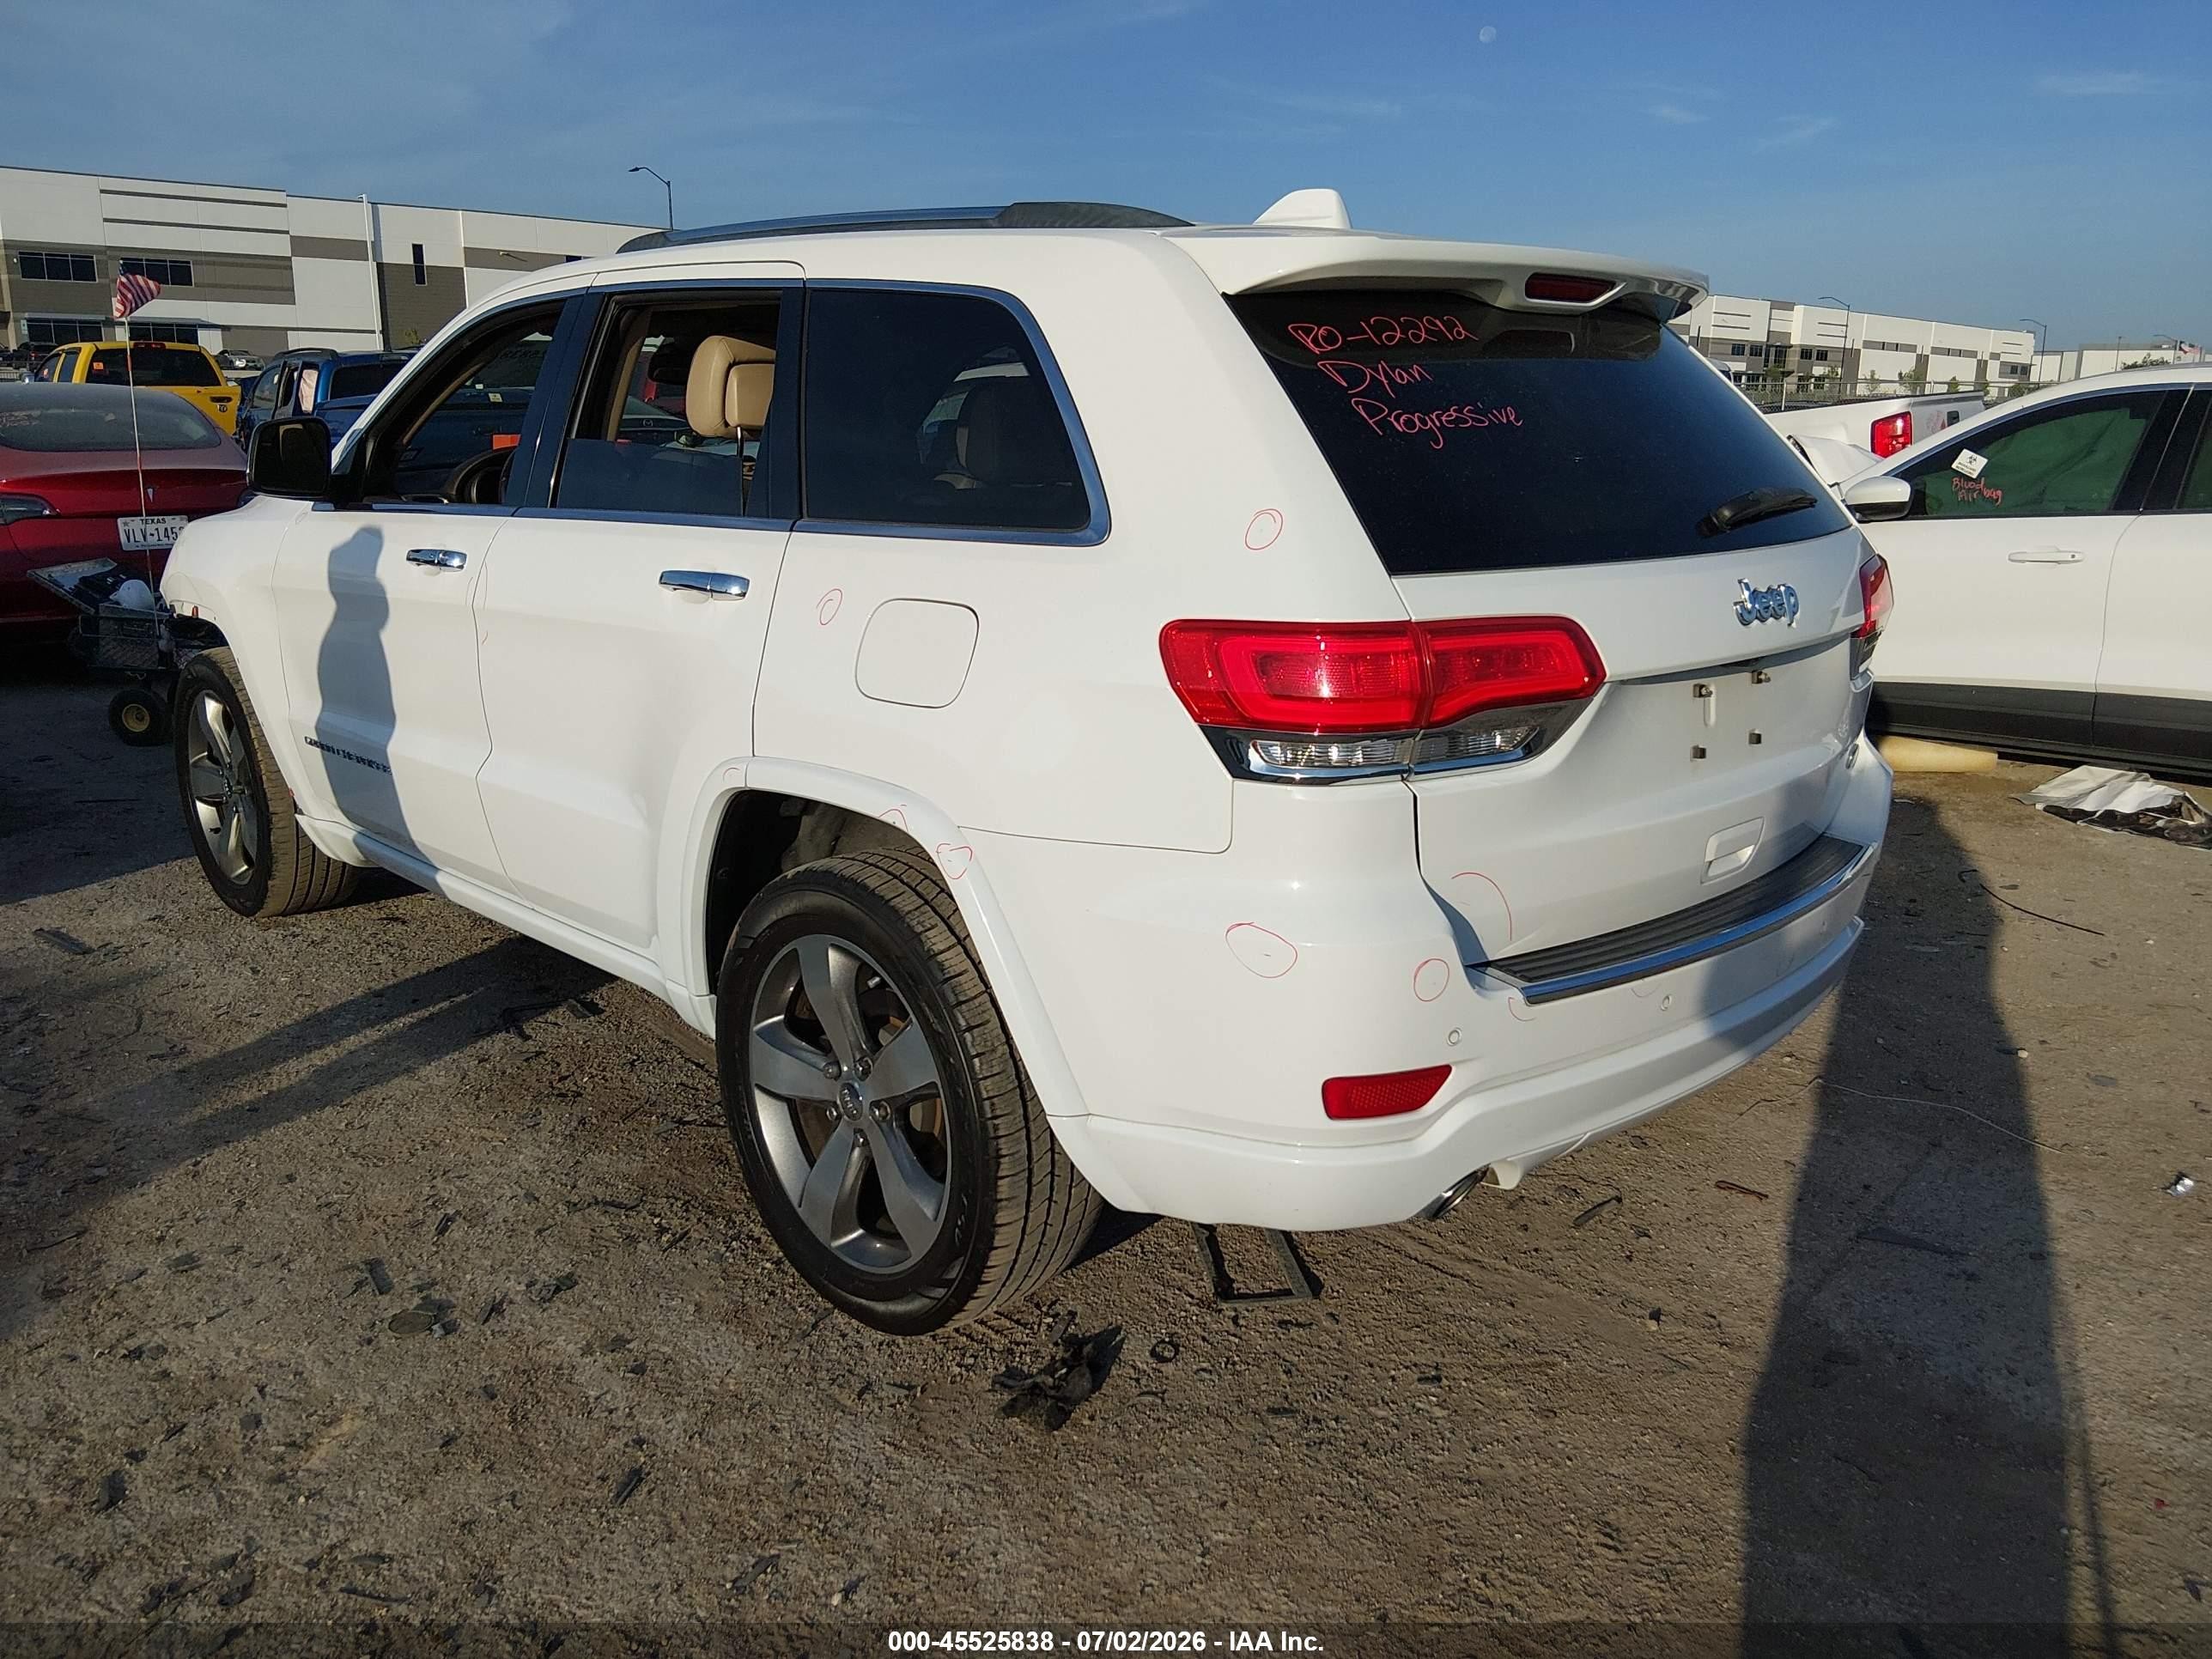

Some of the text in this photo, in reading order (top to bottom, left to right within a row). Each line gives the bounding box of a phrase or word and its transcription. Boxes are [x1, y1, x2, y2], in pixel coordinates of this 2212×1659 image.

[1317, 360, 1433, 398] Dylan
[1351, 397, 1523, 449] Progressive
[1733, 578, 1800, 628] Jeep
